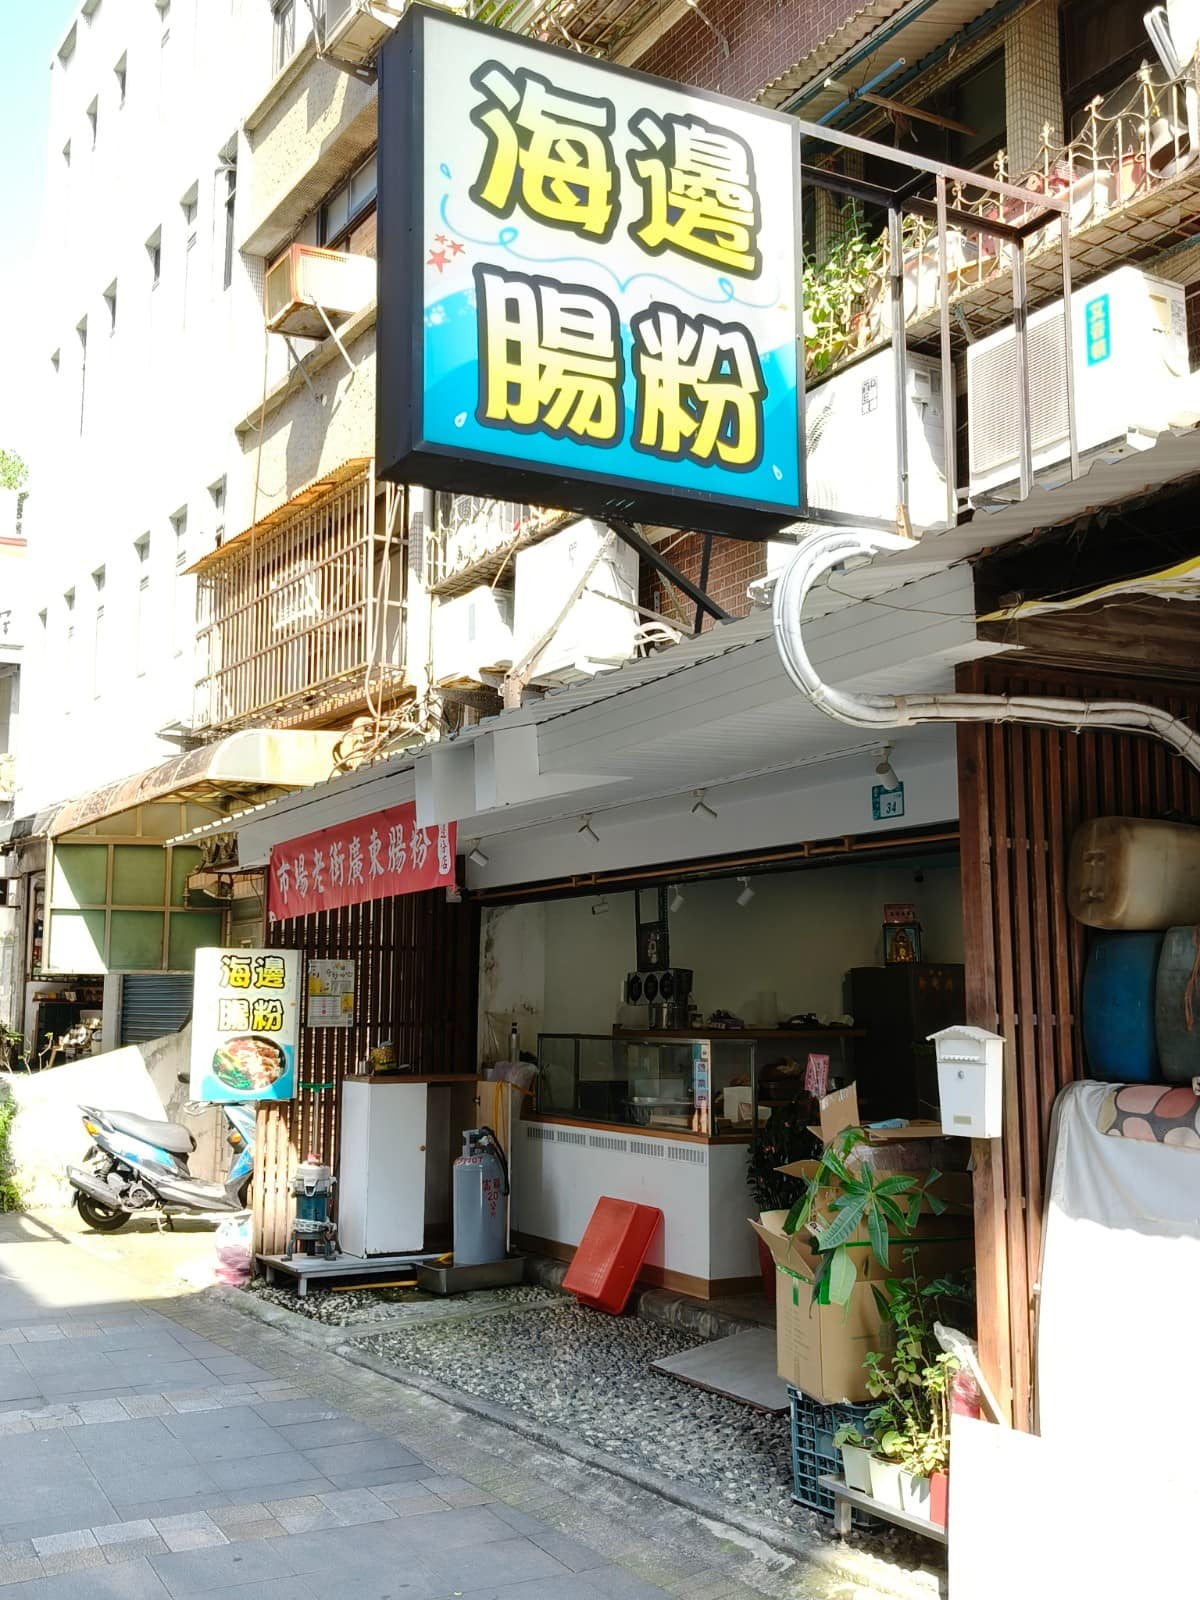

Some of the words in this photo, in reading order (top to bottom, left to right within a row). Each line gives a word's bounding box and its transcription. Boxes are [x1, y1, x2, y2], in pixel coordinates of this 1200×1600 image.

[470, 60, 762, 279] 海邊
[473, 263, 767, 473] 腸粉
[277, 820, 431, 904] 市場老街廣東腸粉
[219, 955, 285, 989] 海邊
